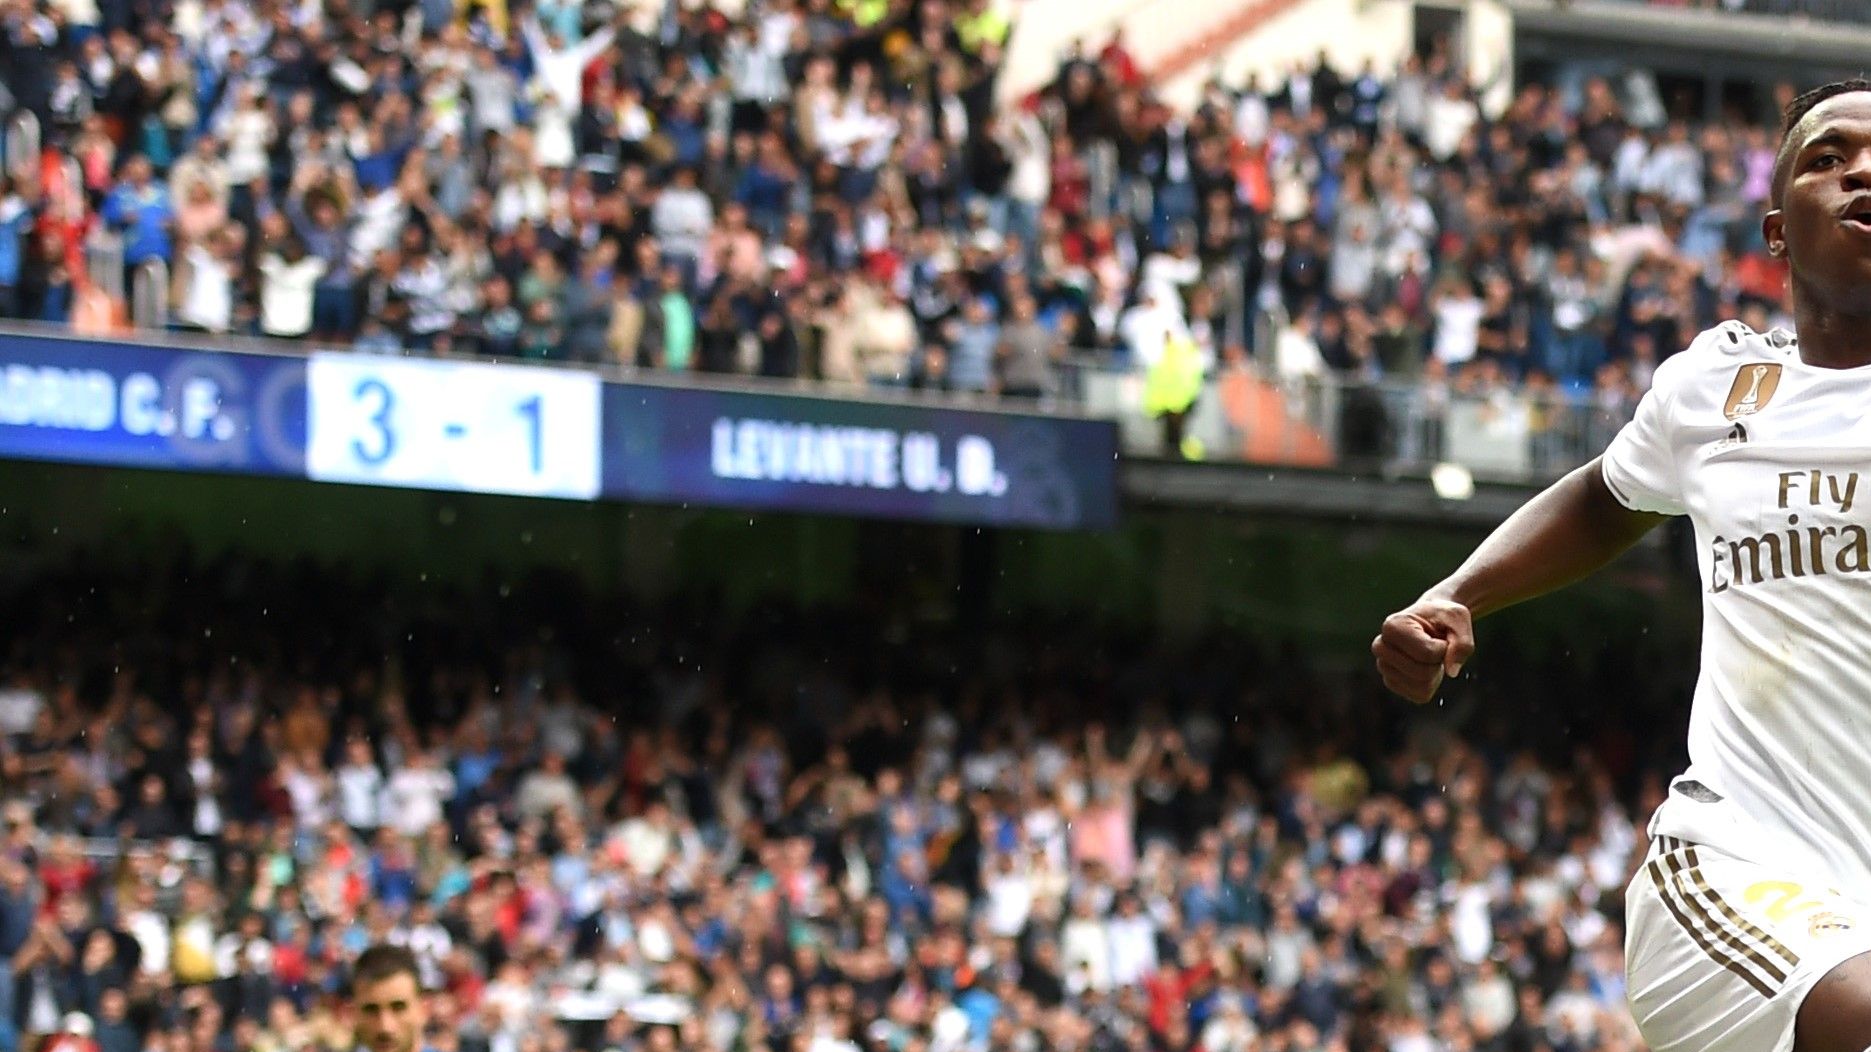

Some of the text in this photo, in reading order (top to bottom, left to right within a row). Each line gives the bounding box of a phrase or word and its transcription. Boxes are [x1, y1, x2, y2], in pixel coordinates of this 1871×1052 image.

[0, 363, 235, 441] DRID C. F.
[351, 378, 396, 466] 3
[514, 394, 542, 476] 1
[710, 416, 1008, 497] LEVANTE U. D.
[1777, 469, 1859, 513] Fly
